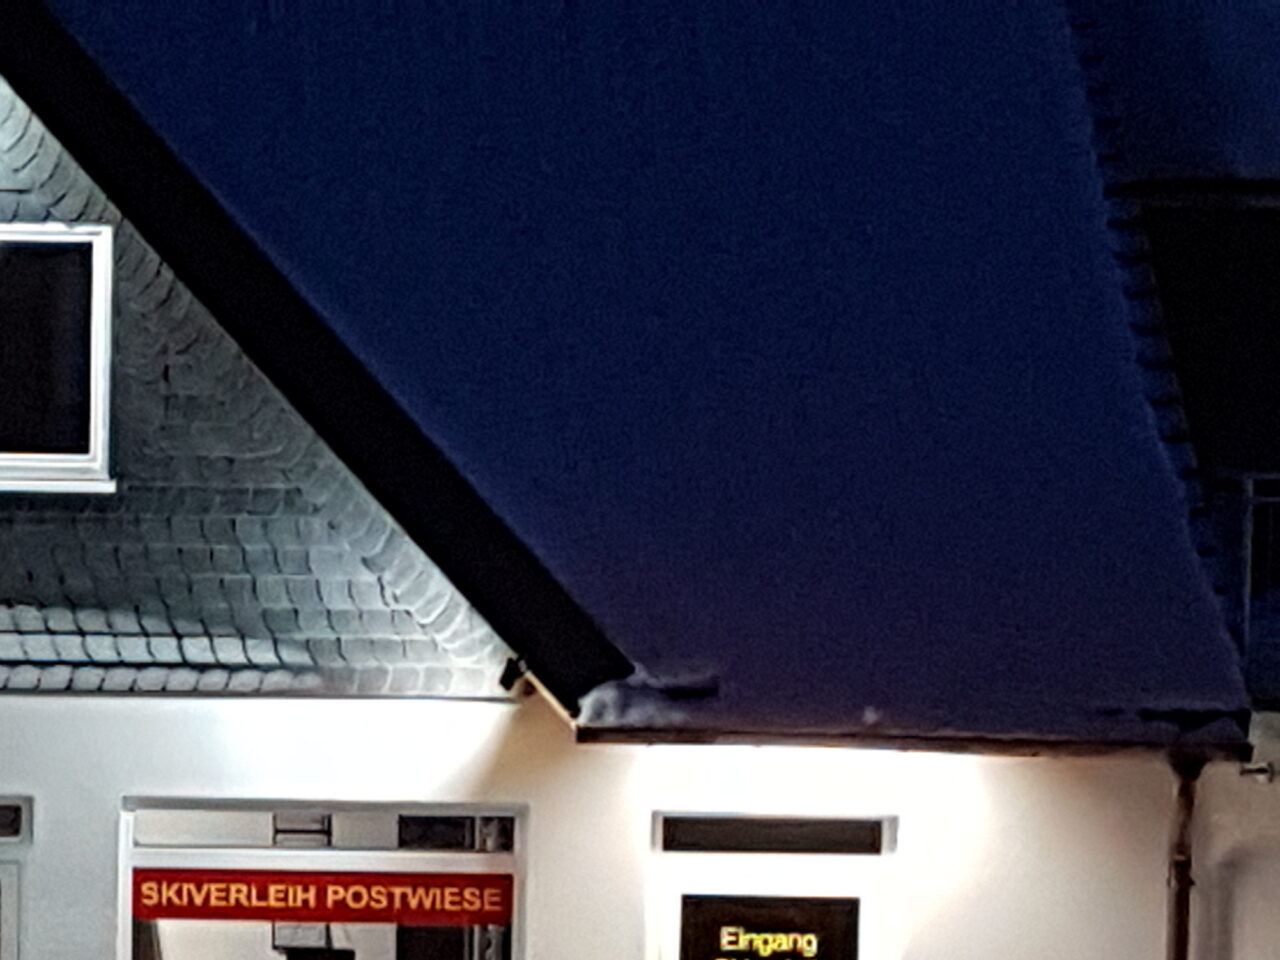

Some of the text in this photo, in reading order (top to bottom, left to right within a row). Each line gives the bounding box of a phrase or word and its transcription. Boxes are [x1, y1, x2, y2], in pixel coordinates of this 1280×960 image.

[140, 882, 503, 912] SKIVERLEIH POSTWIESE
[720, 926, 818, 957] Eingang
